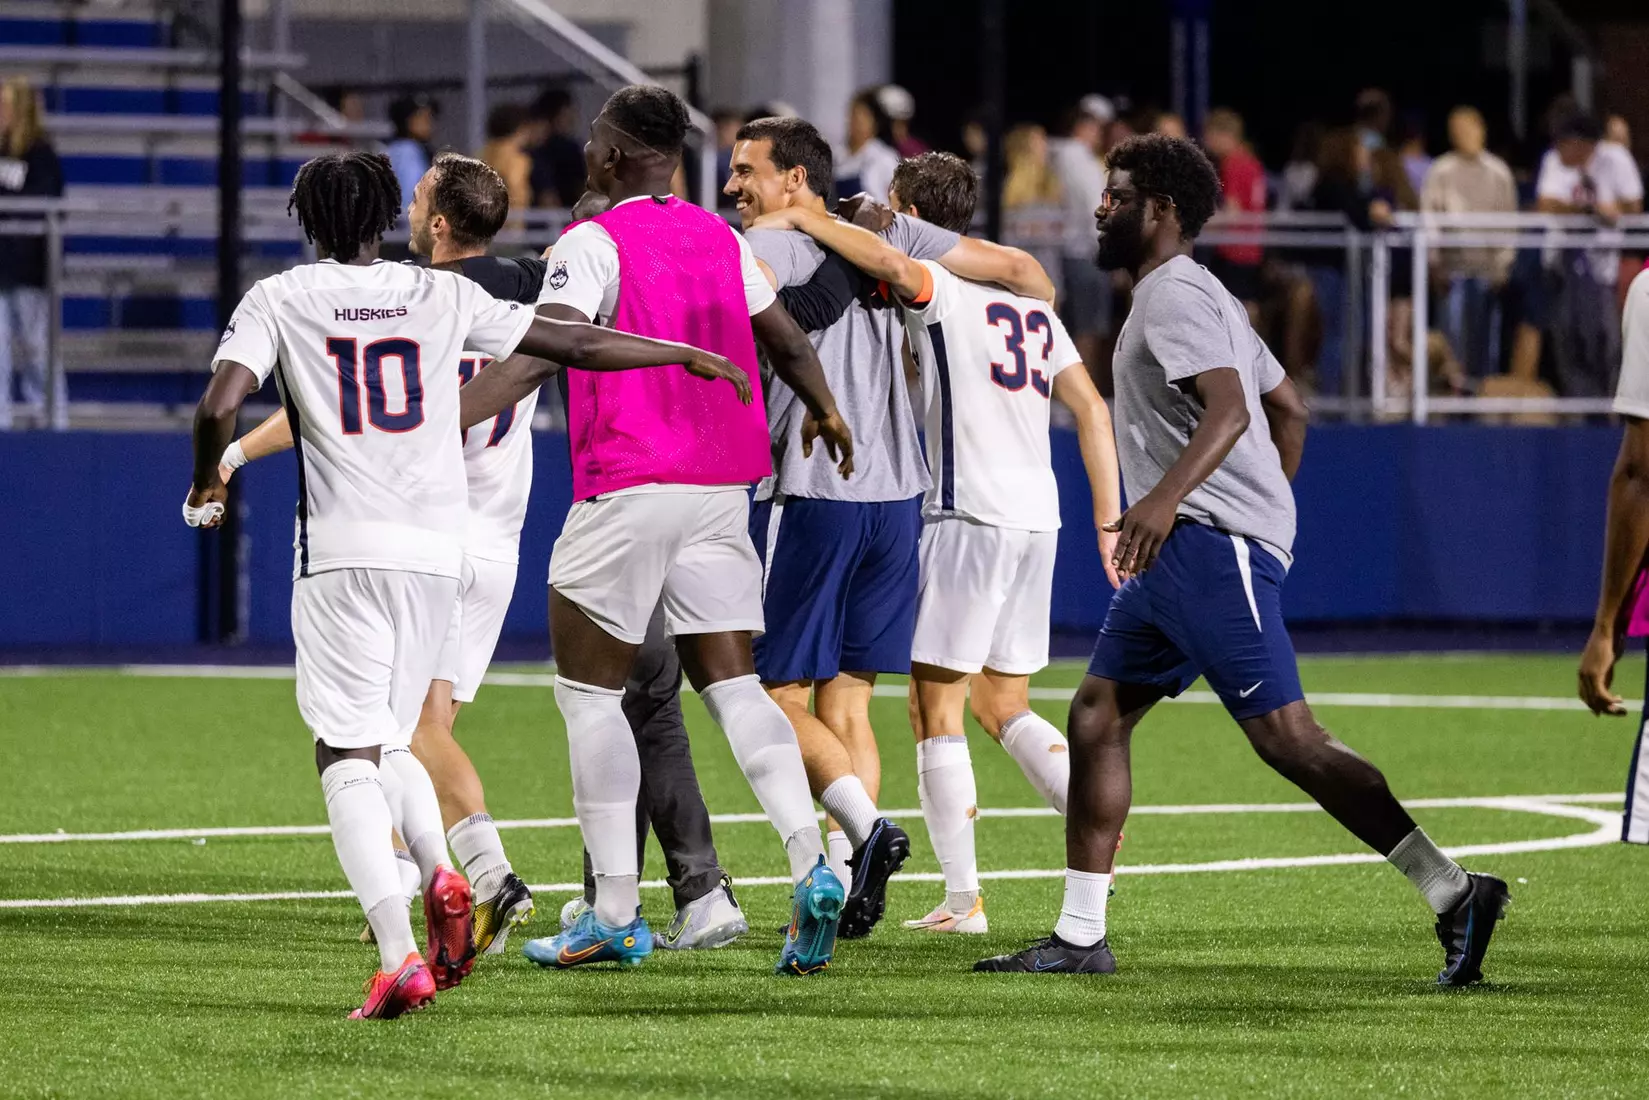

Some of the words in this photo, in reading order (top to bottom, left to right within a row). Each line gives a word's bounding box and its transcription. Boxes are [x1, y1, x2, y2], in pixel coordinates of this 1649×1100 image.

[334, 305, 408, 321] HUSKIES
[985, 302, 1054, 399] 33
[326, 336, 425, 436] 10
